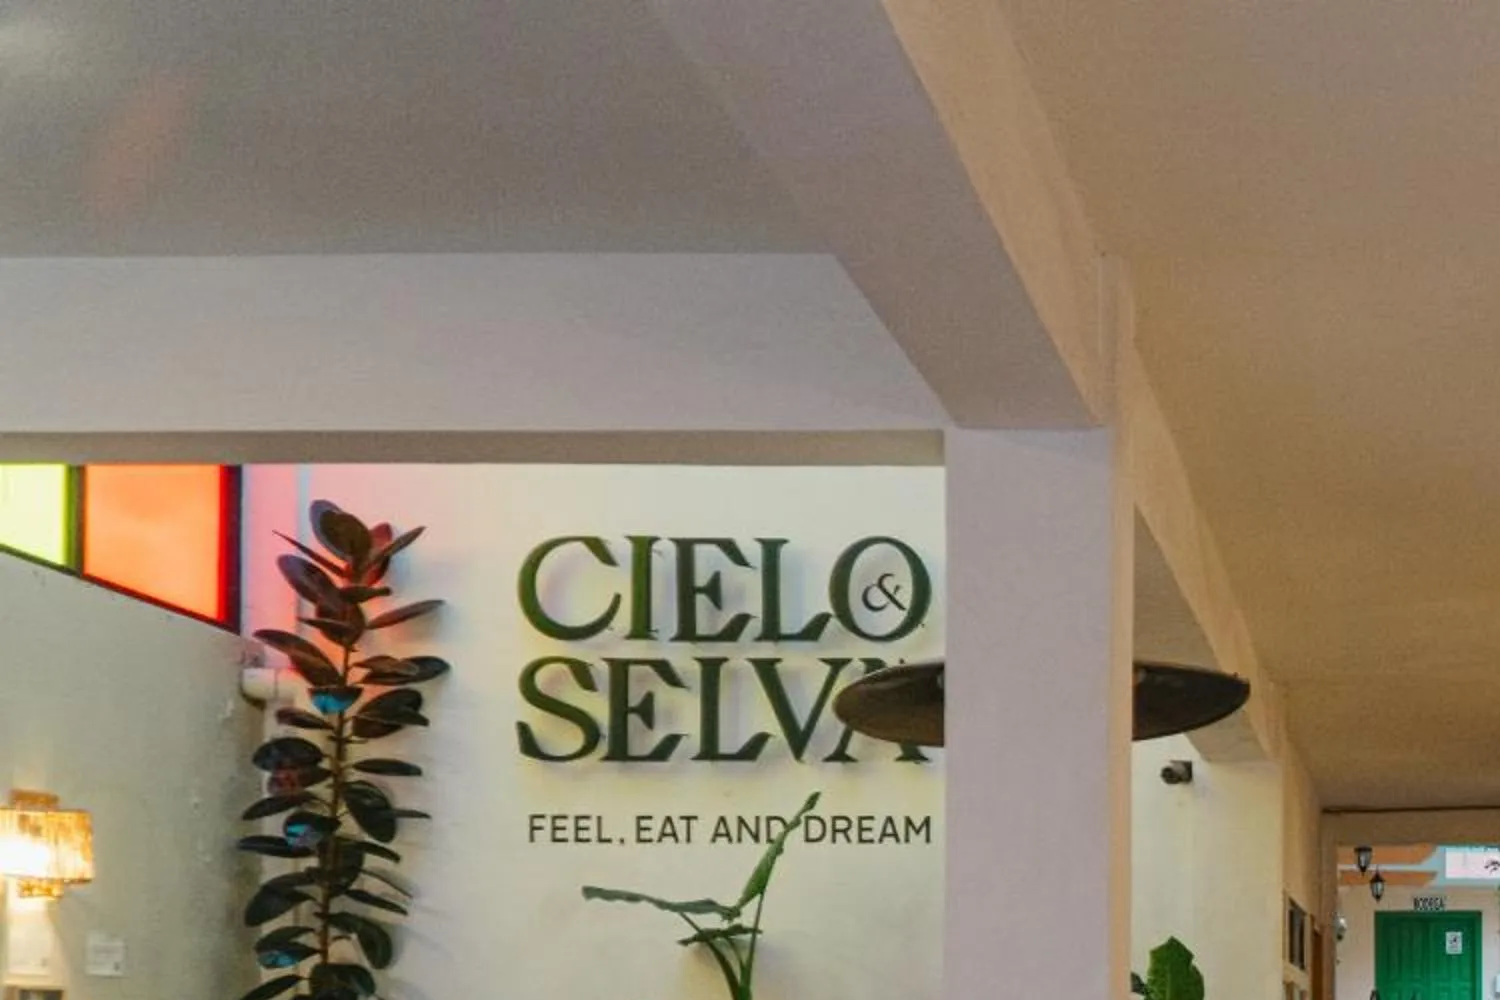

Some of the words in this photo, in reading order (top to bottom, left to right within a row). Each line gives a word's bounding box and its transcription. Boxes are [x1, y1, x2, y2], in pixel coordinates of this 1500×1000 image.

[517, 535, 932, 643] CIELO
[635, 814, 699, 845] EAT
[710, 815, 788, 844] AND
[803, 815, 931, 844] DREAM
